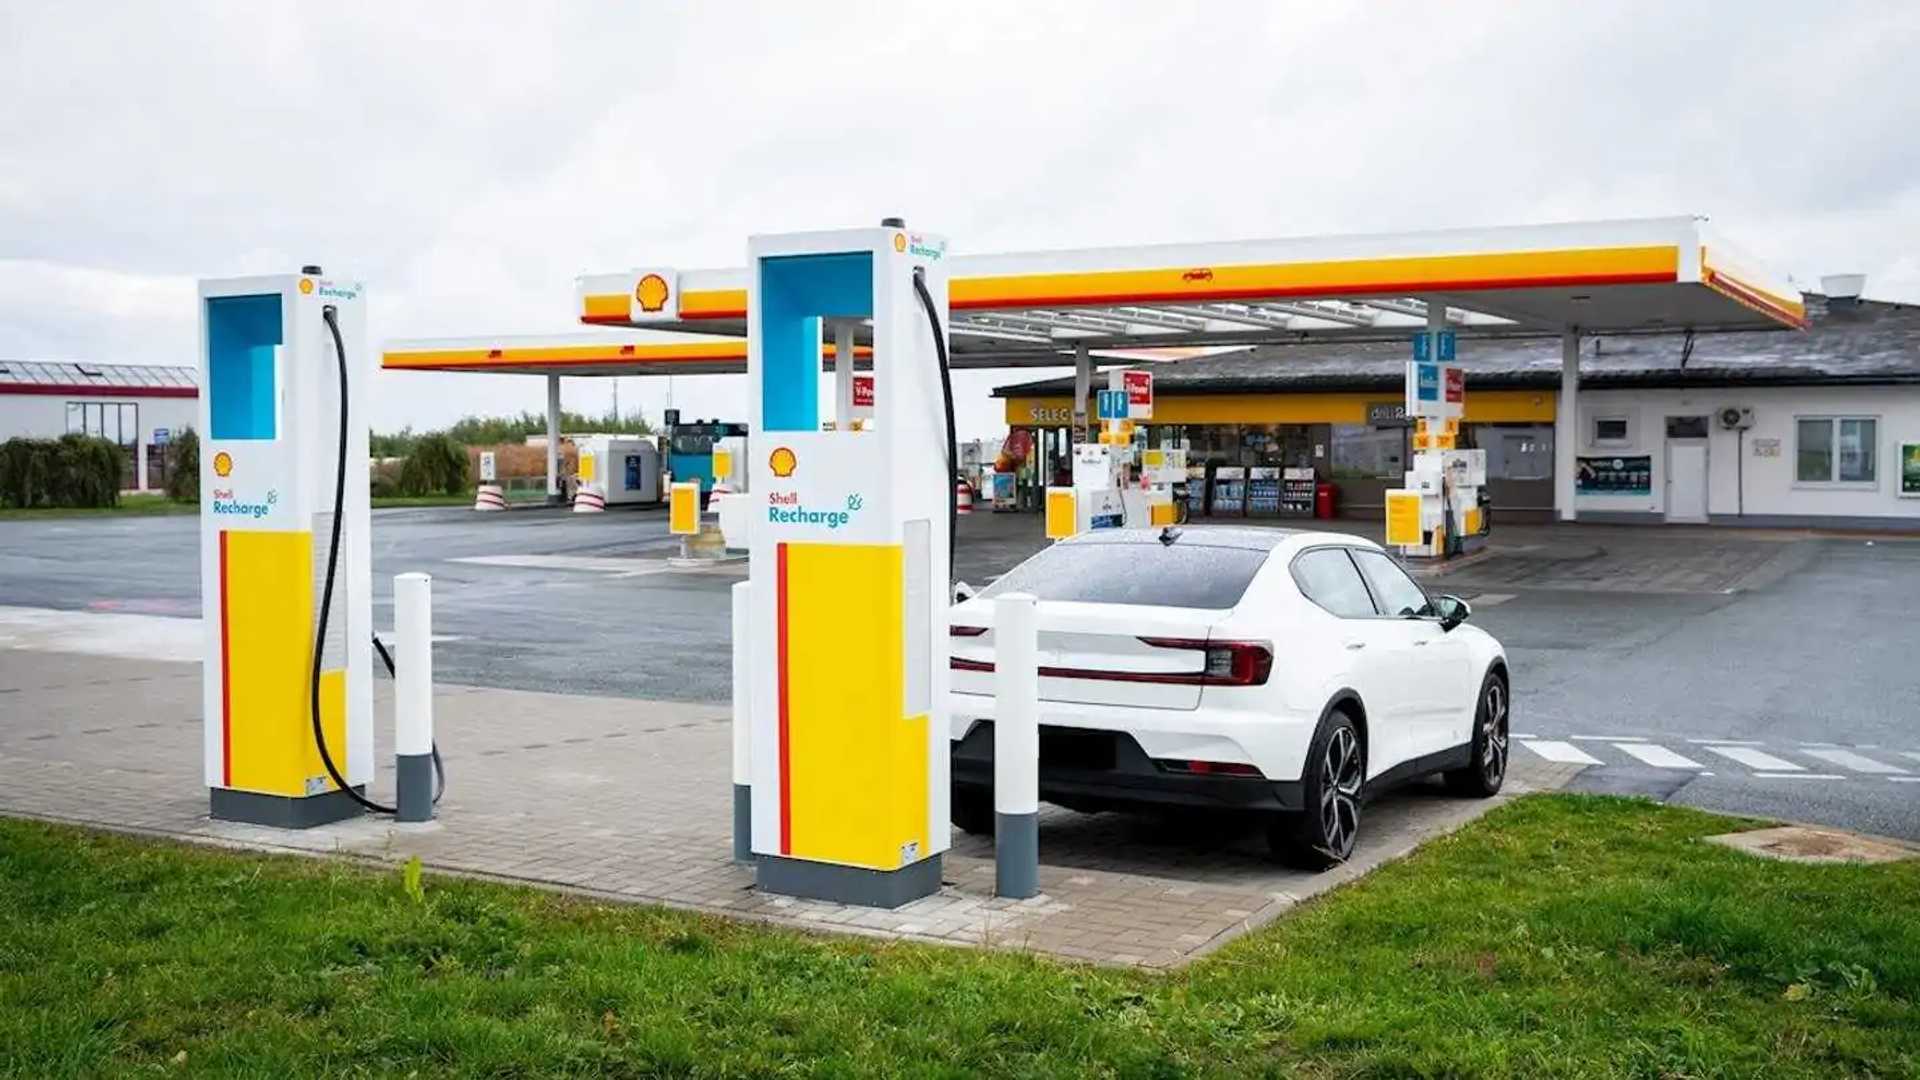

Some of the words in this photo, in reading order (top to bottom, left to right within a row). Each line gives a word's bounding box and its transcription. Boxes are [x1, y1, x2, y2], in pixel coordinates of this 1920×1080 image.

[1030, 408, 1071, 421] SELEC
[769, 491, 797, 505] Shell
[213, 500, 268, 518] Recharge
[769, 506, 848, 528] Recharge
